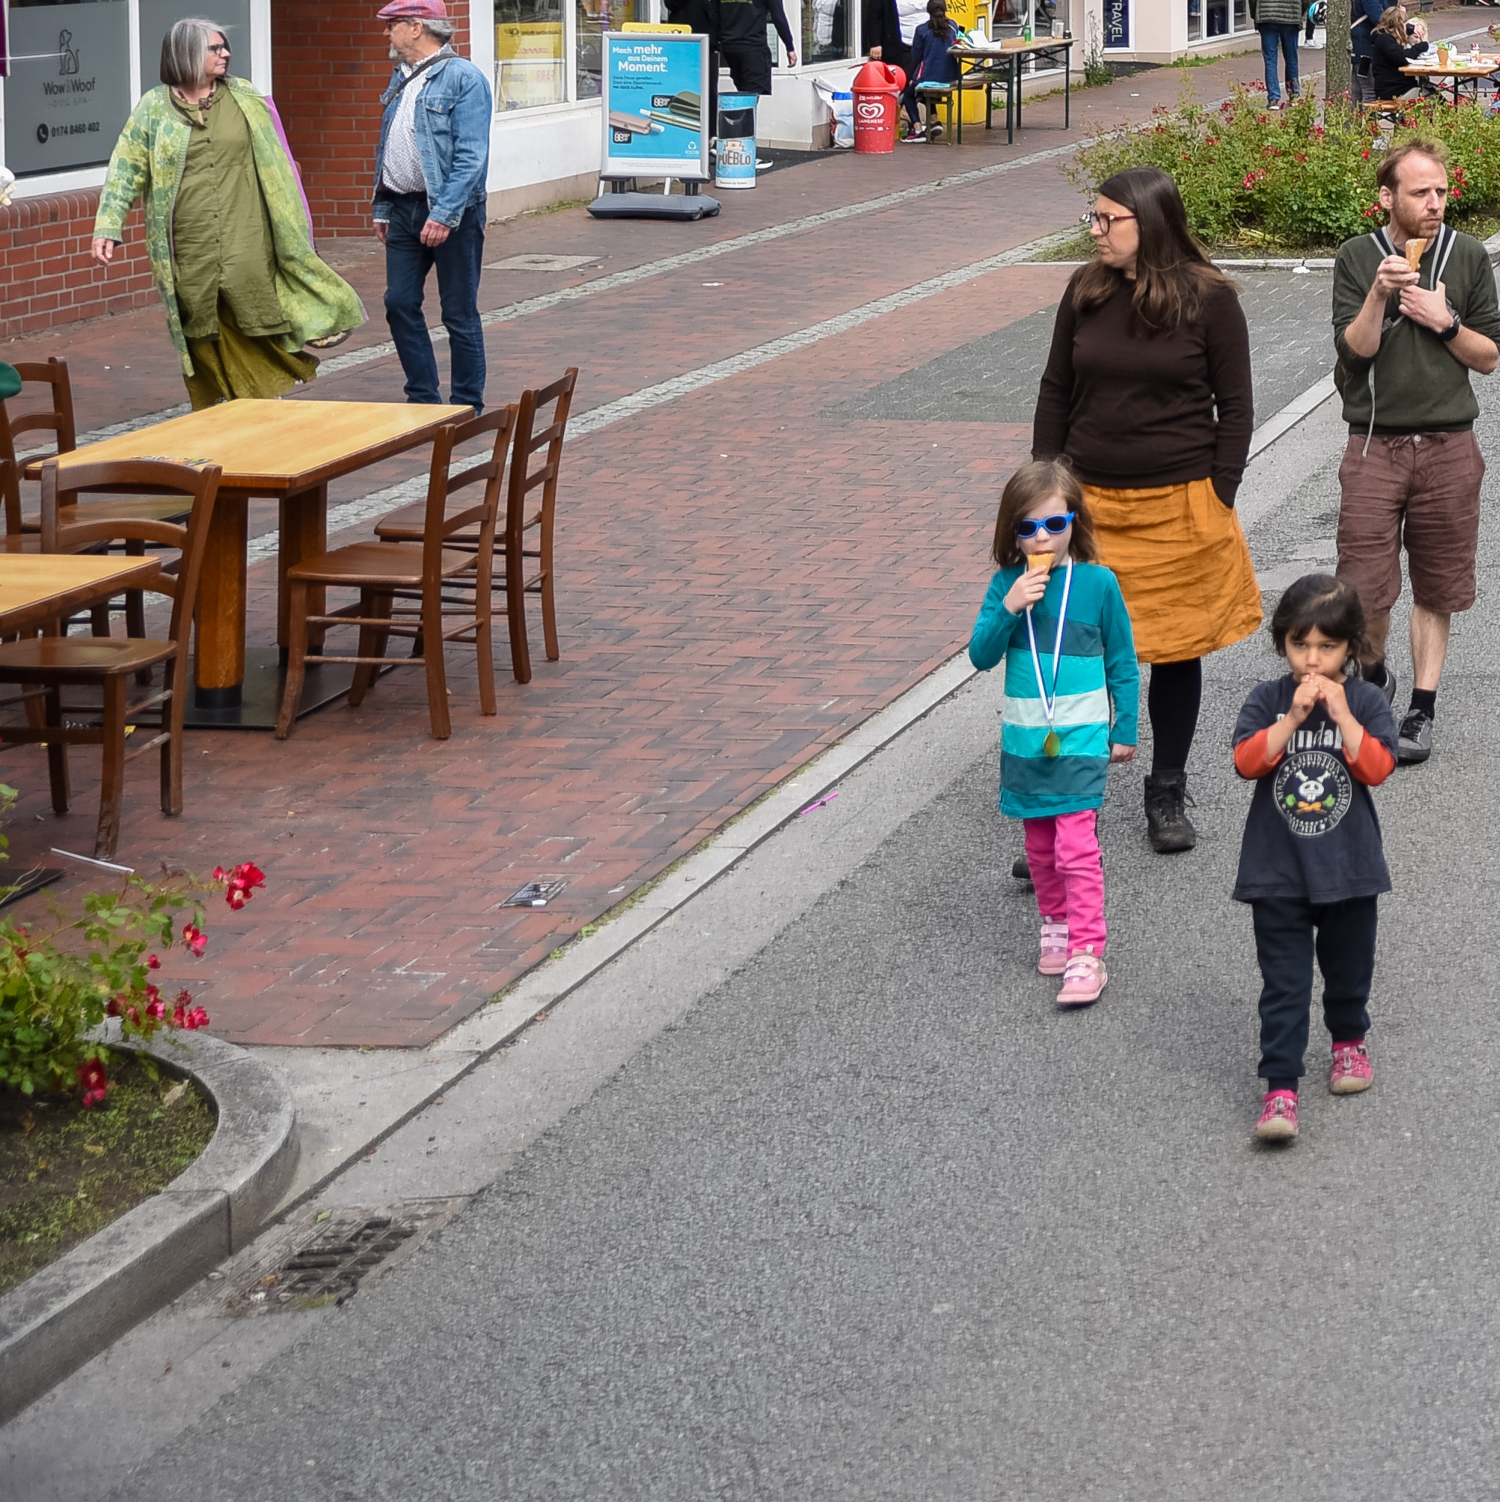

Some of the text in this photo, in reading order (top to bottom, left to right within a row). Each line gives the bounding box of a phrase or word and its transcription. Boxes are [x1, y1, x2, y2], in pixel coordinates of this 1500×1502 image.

[634, 43, 663, 54] mehr
[618, 61, 668, 72] Moment.
[43, 76, 96, 95] Wow Woof
[718, 149, 751, 166] PUEBLO
